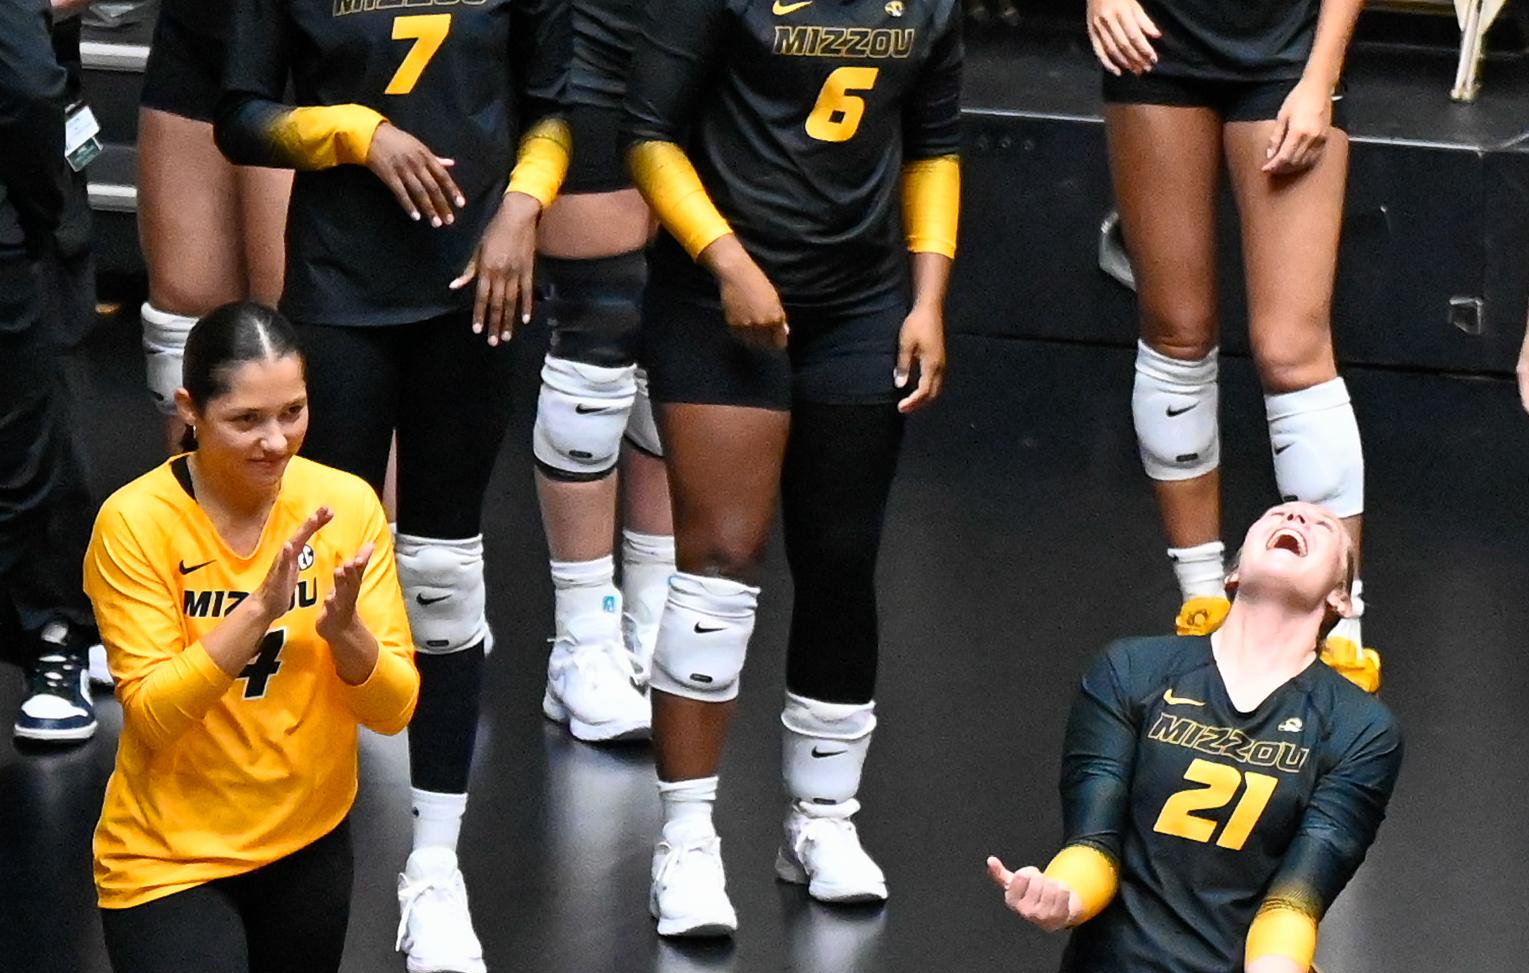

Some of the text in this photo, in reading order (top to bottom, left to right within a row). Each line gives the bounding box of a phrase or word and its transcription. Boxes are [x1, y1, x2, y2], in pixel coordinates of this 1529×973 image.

[384, 13, 452, 95] 7
[772, 26, 914, 58] MIZZOU
[805, 66, 879, 143] 6
[183, 577, 318, 618] MIZU
[237, 628, 286, 699] 4
[1147, 712, 1310, 773] MIZZOU
[1153, 757, 1279, 851] 21
